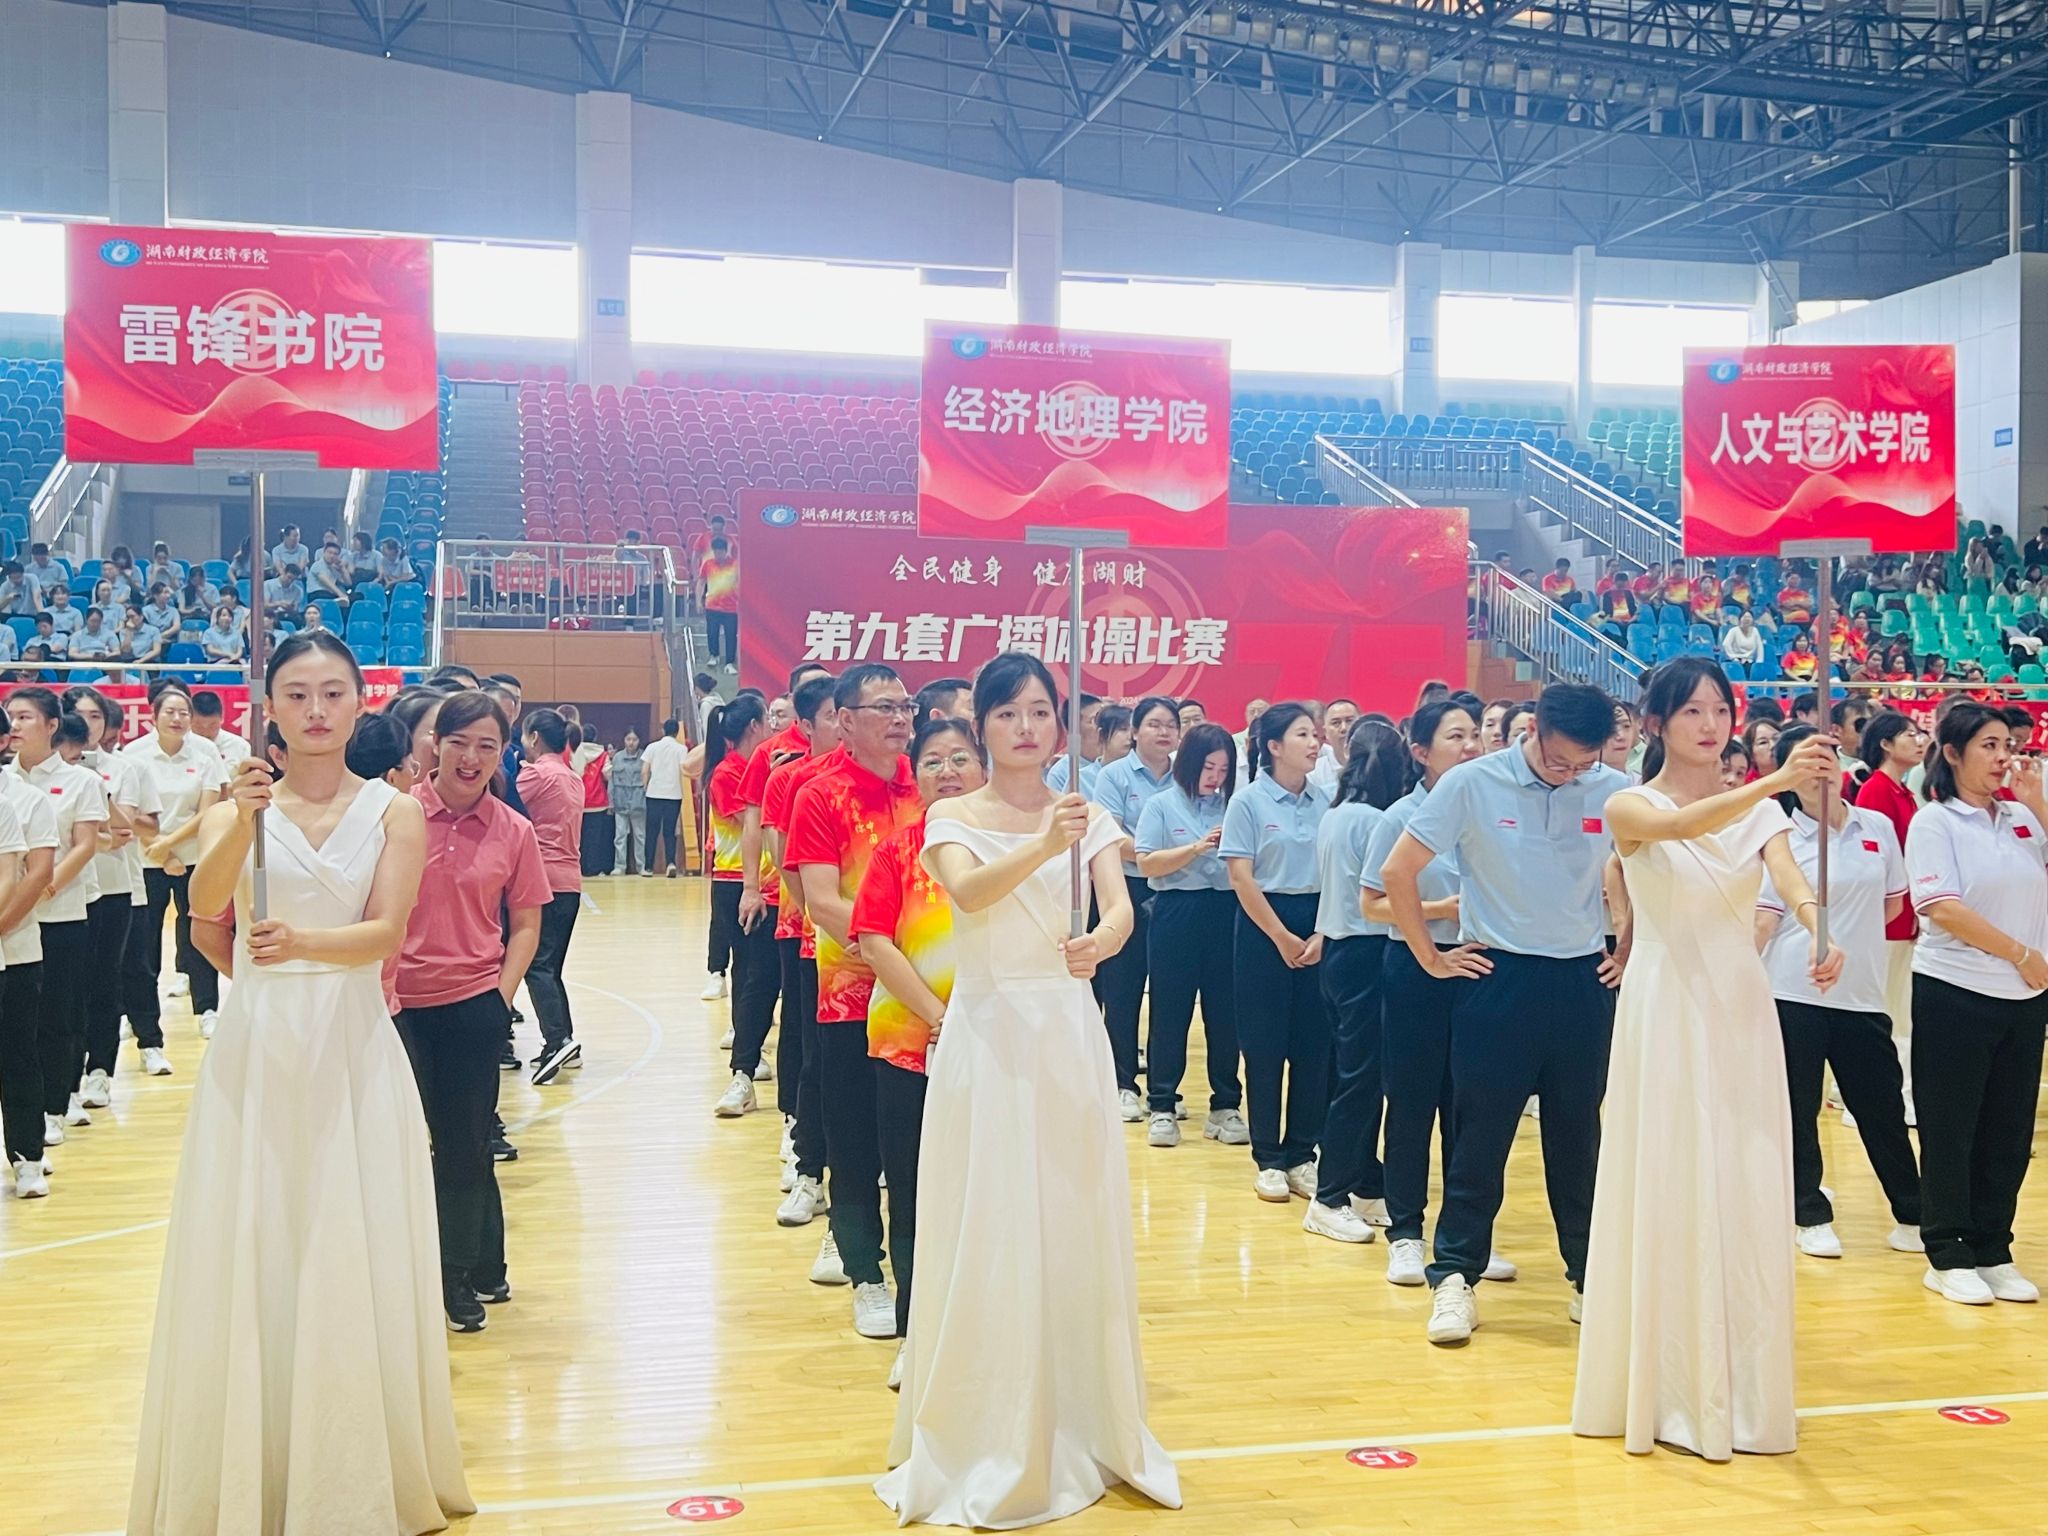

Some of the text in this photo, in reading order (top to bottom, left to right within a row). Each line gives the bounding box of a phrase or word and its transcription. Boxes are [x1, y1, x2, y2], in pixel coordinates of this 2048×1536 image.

[146, 244, 269, 264] 湖南财政经济学院
[119, 304, 385, 371] 雷锋书院
[990, 337, 1093, 359] 湖南财政经济学院
[944, 385, 1208, 445] 经济地理学院
[1710, 411, 1931, 465] 人文与艺术学院
[801, 507, 917, 525] 湖南财政经济学院
[889, 554, 1003, 586] 全民健身
[802, 610, 1228, 666] 第九套广播体操比赛
